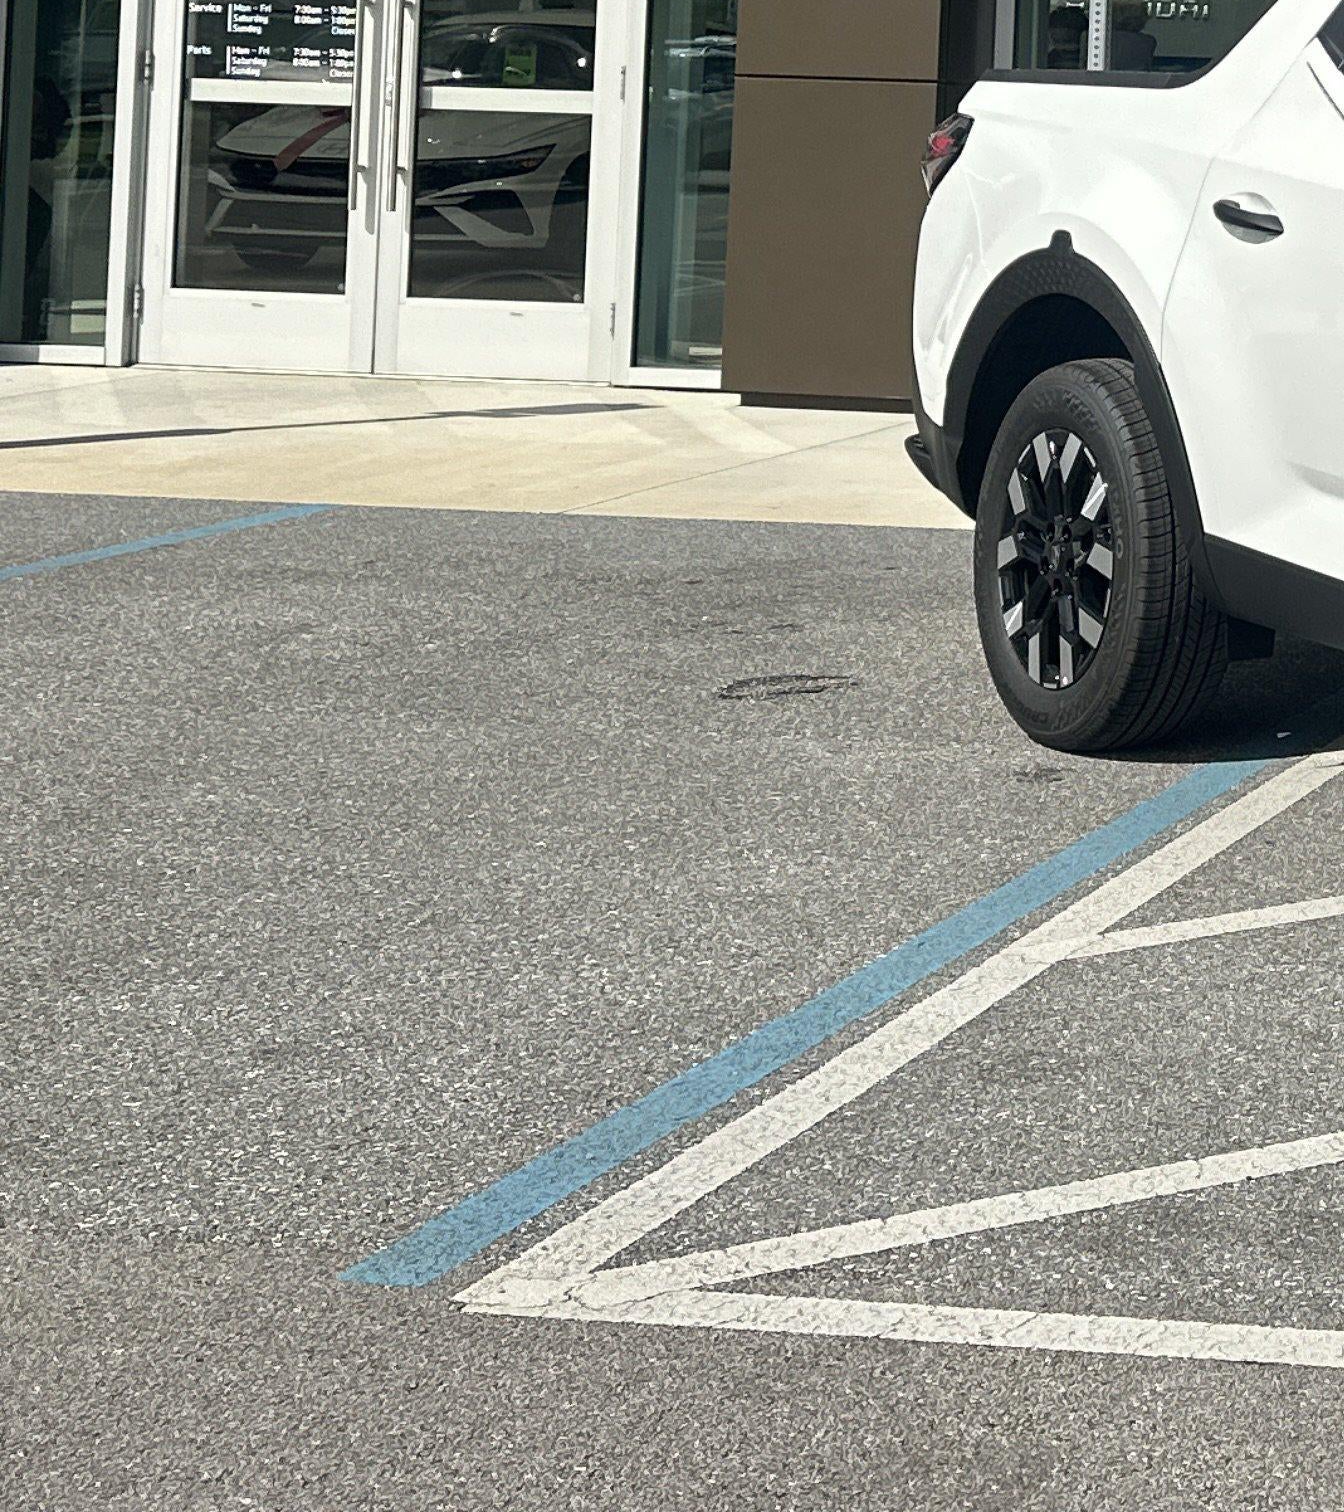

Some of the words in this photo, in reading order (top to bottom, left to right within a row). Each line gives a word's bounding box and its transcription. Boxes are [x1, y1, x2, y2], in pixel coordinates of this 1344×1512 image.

[189, 3, 222, 13] Service
[234, 4, 252, 13] Mon
[260, 4, 272, 13] Fri
[233, 14, 269, 25] Saturday
[233, 24, 262, 35] Sunday
[186, 45, 212, 55] Parts
[258, 46, 271, 56] Fri
[231, 56, 268, 68] Saturday
[231, 67, 261, 78] Sunday
